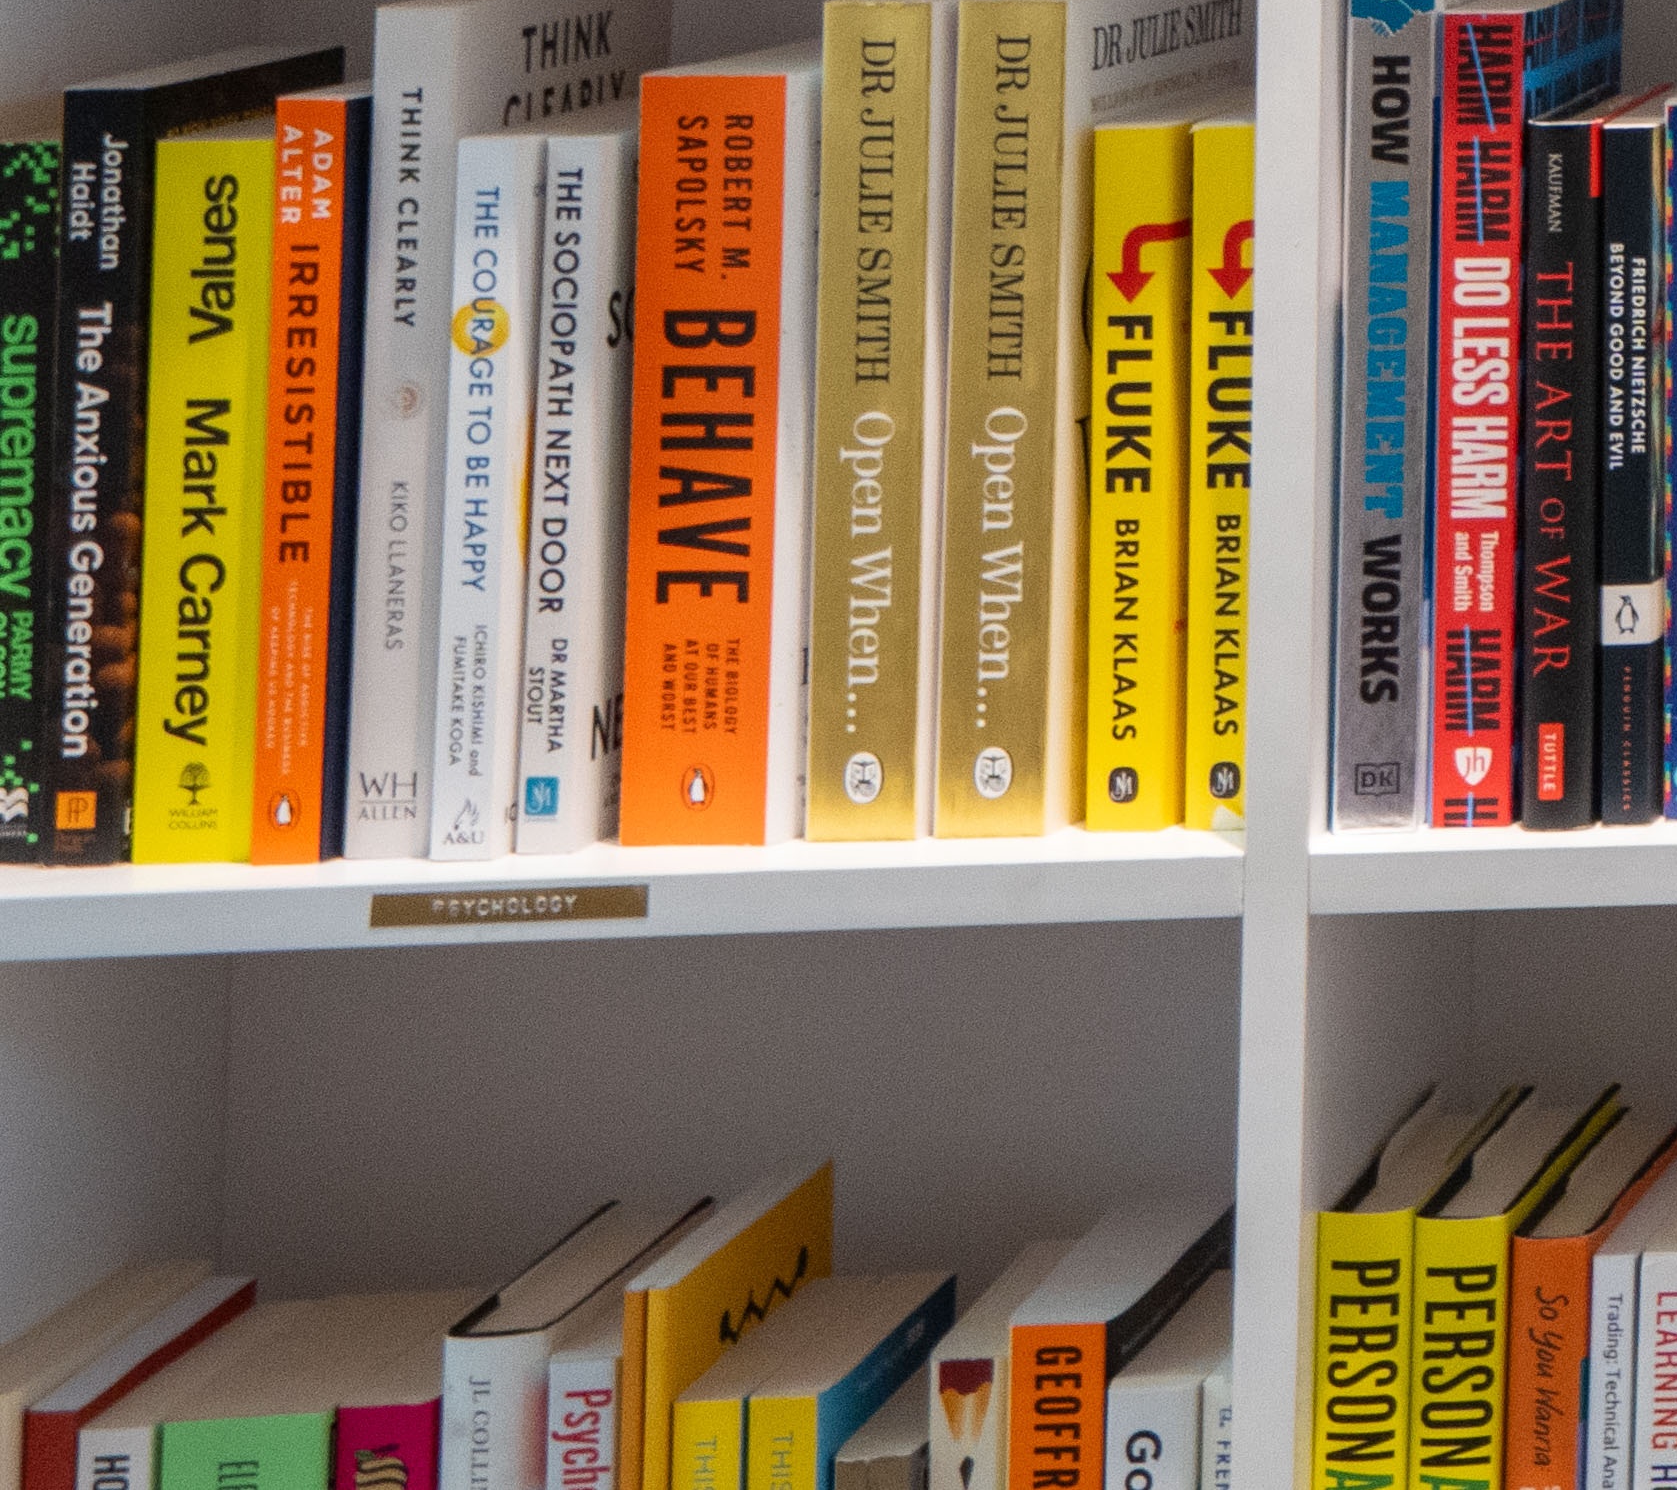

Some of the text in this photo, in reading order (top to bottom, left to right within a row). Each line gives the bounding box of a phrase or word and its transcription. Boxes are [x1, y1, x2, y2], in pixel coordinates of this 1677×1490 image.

[1371, 54, 1411, 166] HOW
[188, 173, 238, 345] Values
[655, 308, 758, 605] BEHAVE
[1106, 314, 1153, 493] FLUKE
[1450, 257, 1511, 519] DO LESS HARM
[164, 397, 232, 747] Mark Carney
[1111, 519, 1140, 741] BRIAN KLAAS
[1359, 533, 1402, 705] WORKS
